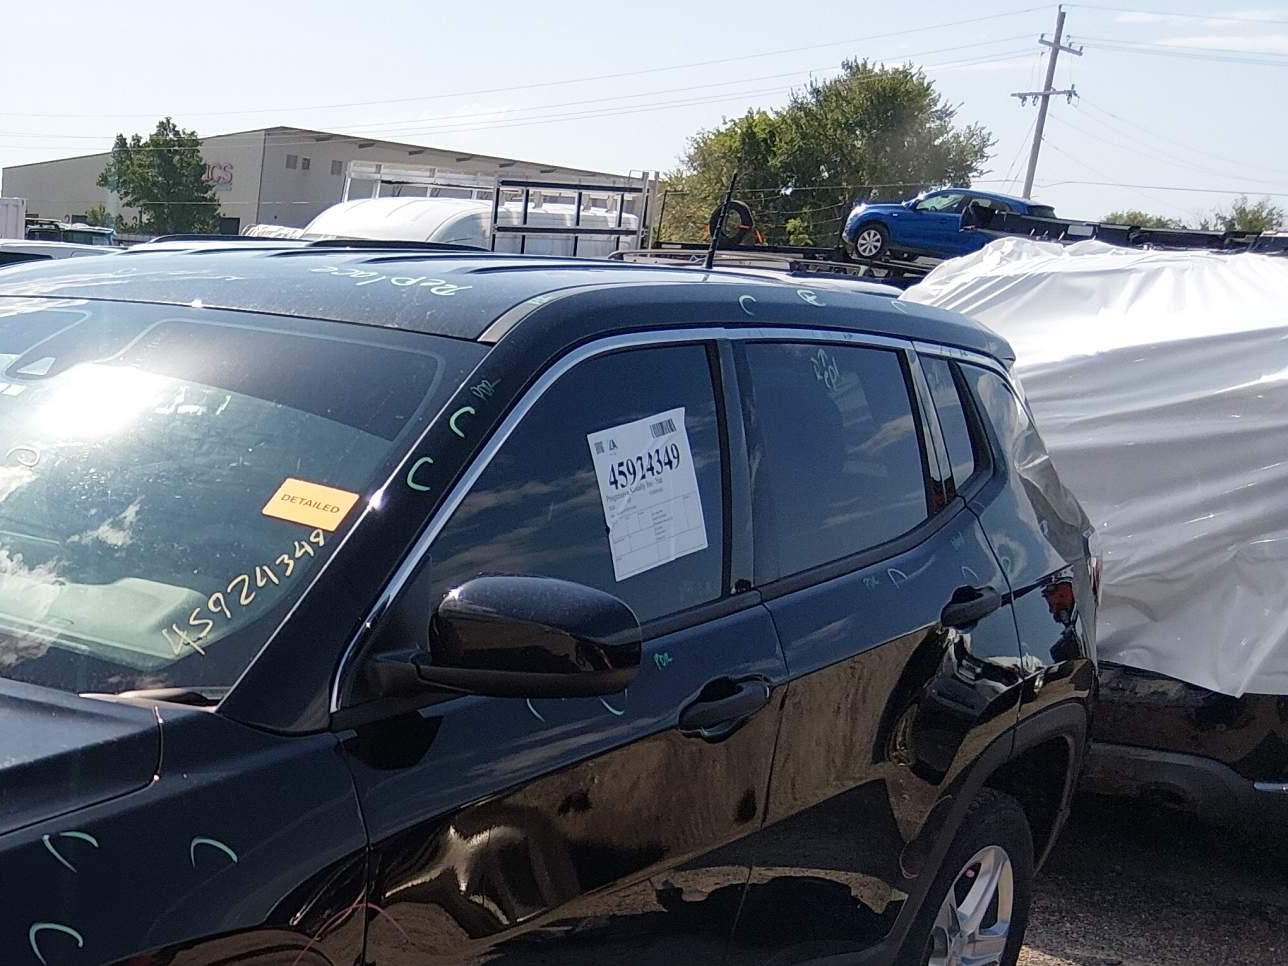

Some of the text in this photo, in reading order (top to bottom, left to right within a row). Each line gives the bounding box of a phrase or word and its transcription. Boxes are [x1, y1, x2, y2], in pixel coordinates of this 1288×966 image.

[608, 442, 680, 491] 45924349
[280, 492, 340, 514] DETAILED
[161, 527, 325, 656] 45924349
